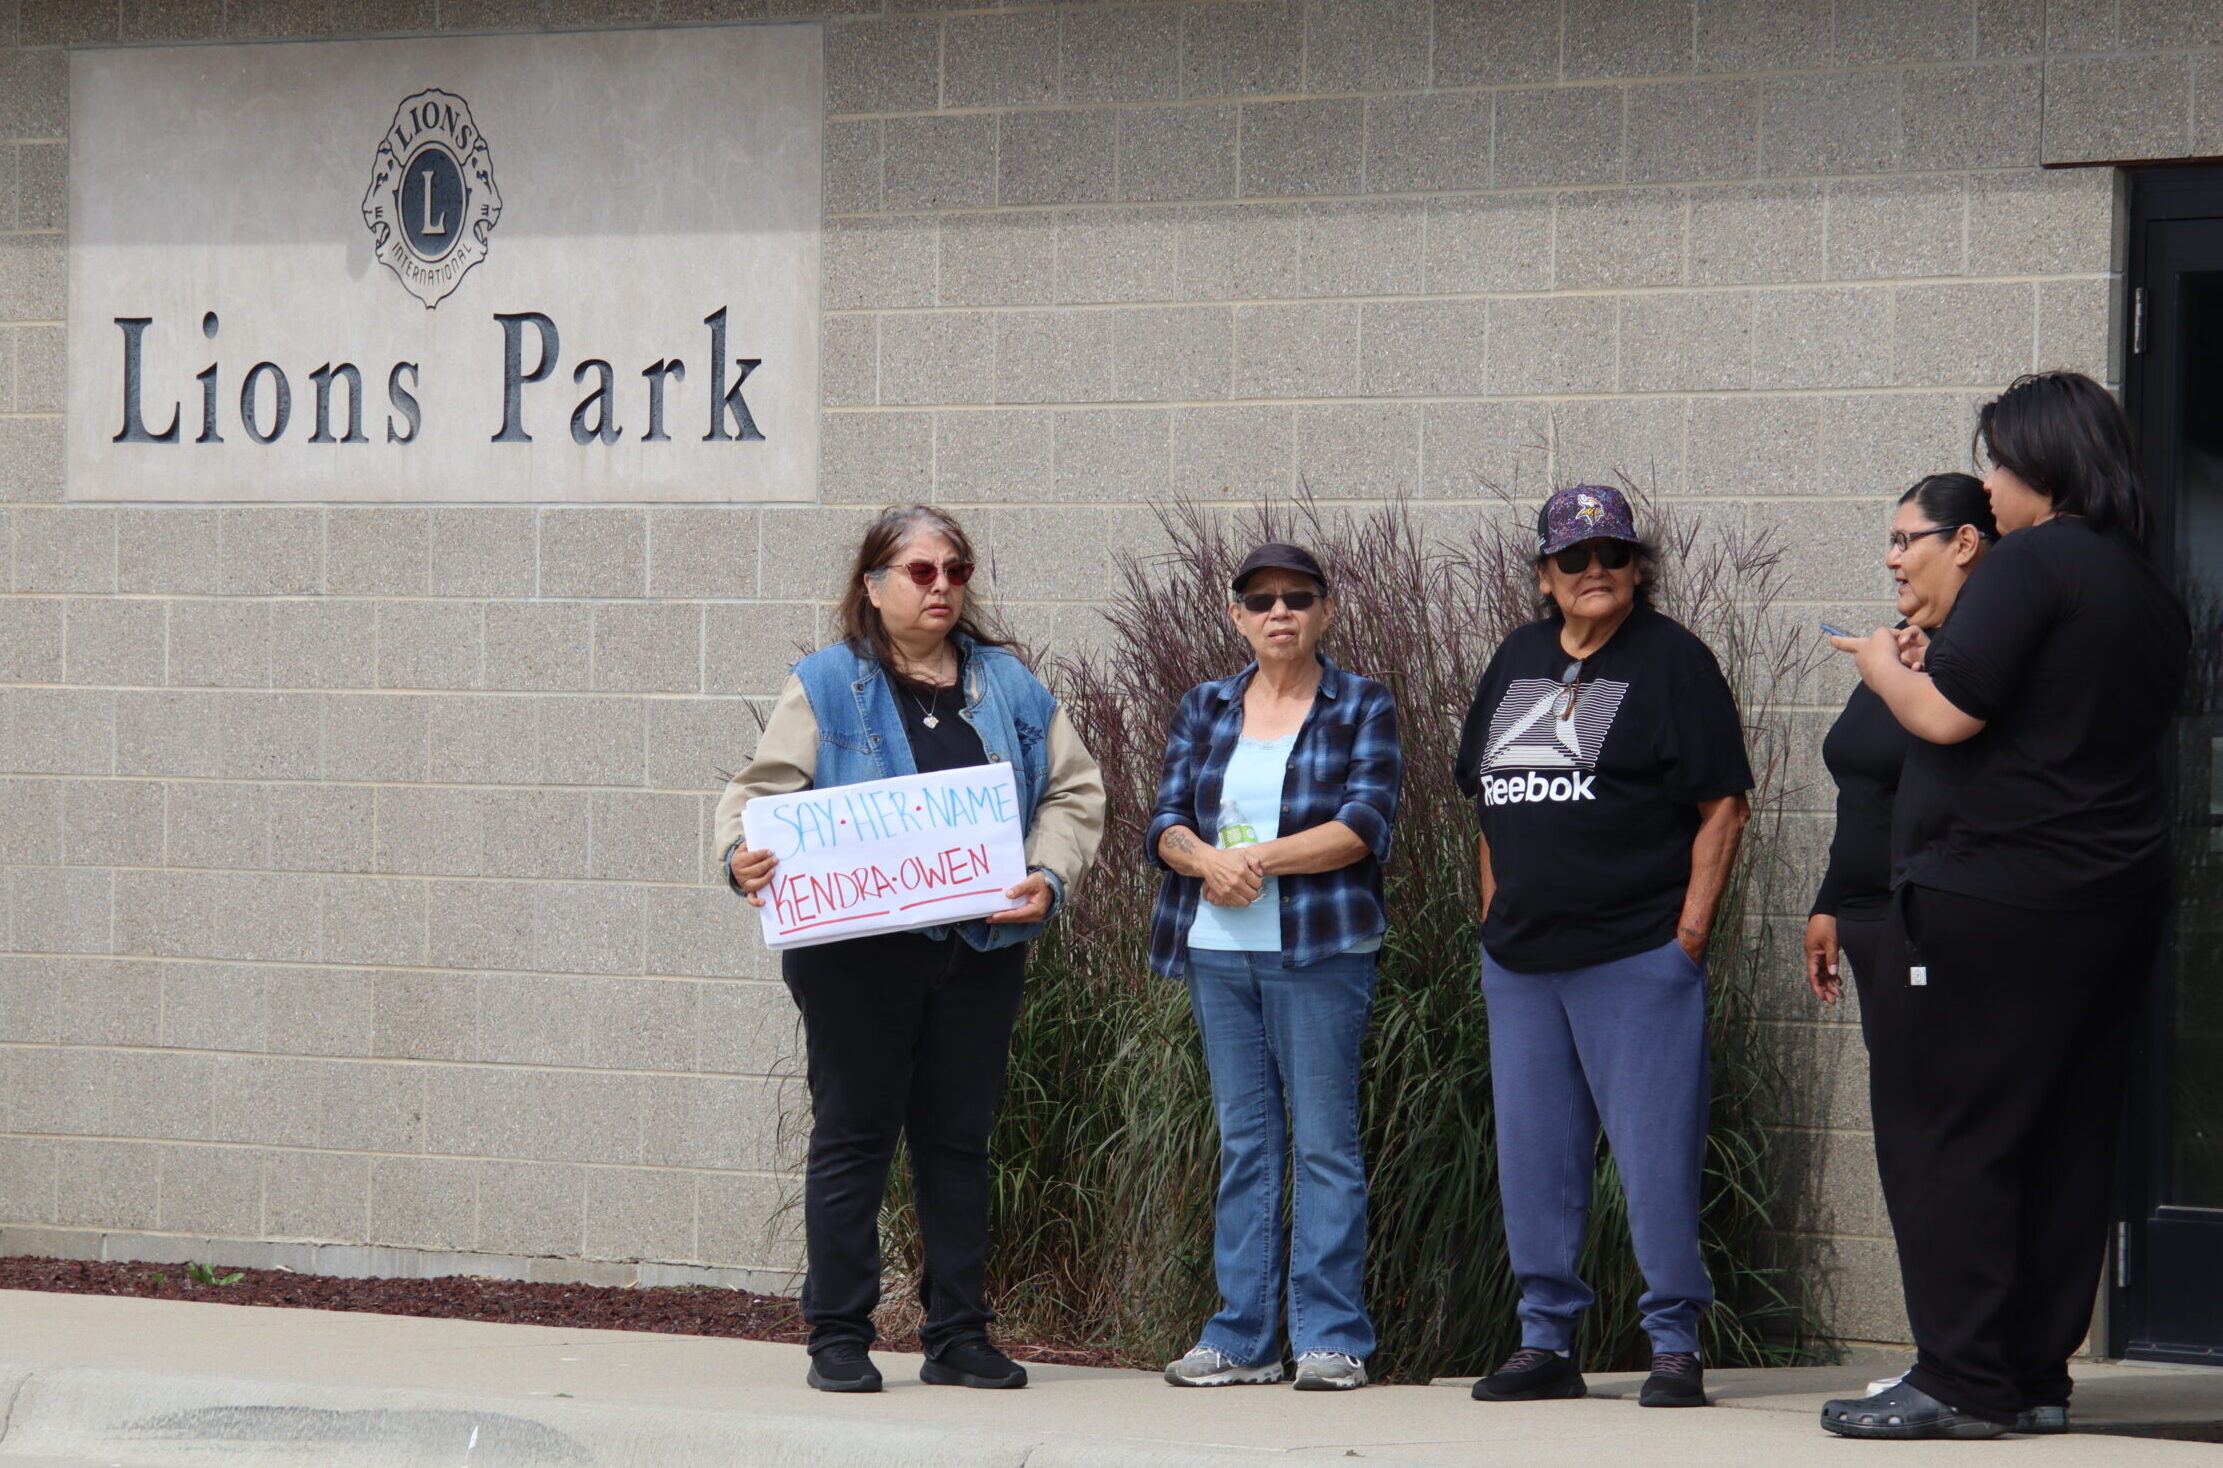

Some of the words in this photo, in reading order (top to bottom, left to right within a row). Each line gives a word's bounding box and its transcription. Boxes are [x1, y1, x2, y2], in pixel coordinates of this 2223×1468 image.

[395, 101, 472, 151] LIONS
[421, 170, 447, 234] L
[392, 241, 472, 286] INTERNATIONAL
[112, 310, 422, 446] Lions
[490, 304, 766, 446] Park
[1480, 771, 1597, 807] Reebok
